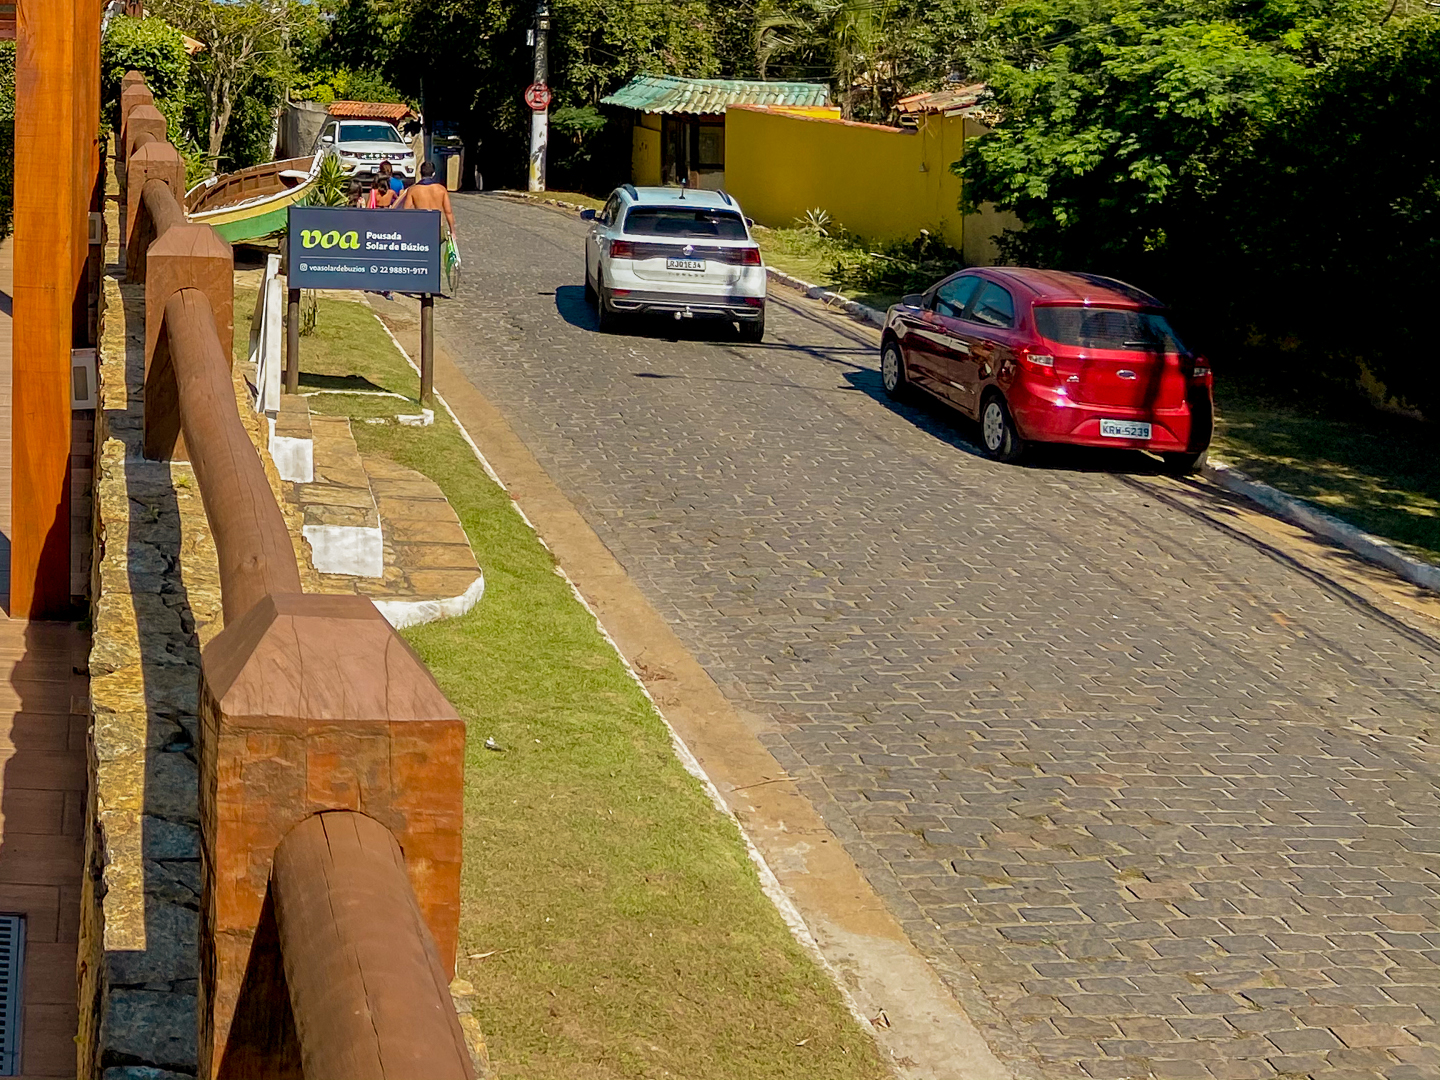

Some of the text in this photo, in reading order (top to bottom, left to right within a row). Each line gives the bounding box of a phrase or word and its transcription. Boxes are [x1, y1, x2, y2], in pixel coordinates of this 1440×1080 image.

[300, 229, 361, 250] voa
[366, 231, 402, 241] Pousada
[365, 241, 430, 252] Solar de Búzios
[308, 264, 366, 274] voasolardebuzios
[379, 266, 389, 274] 22
